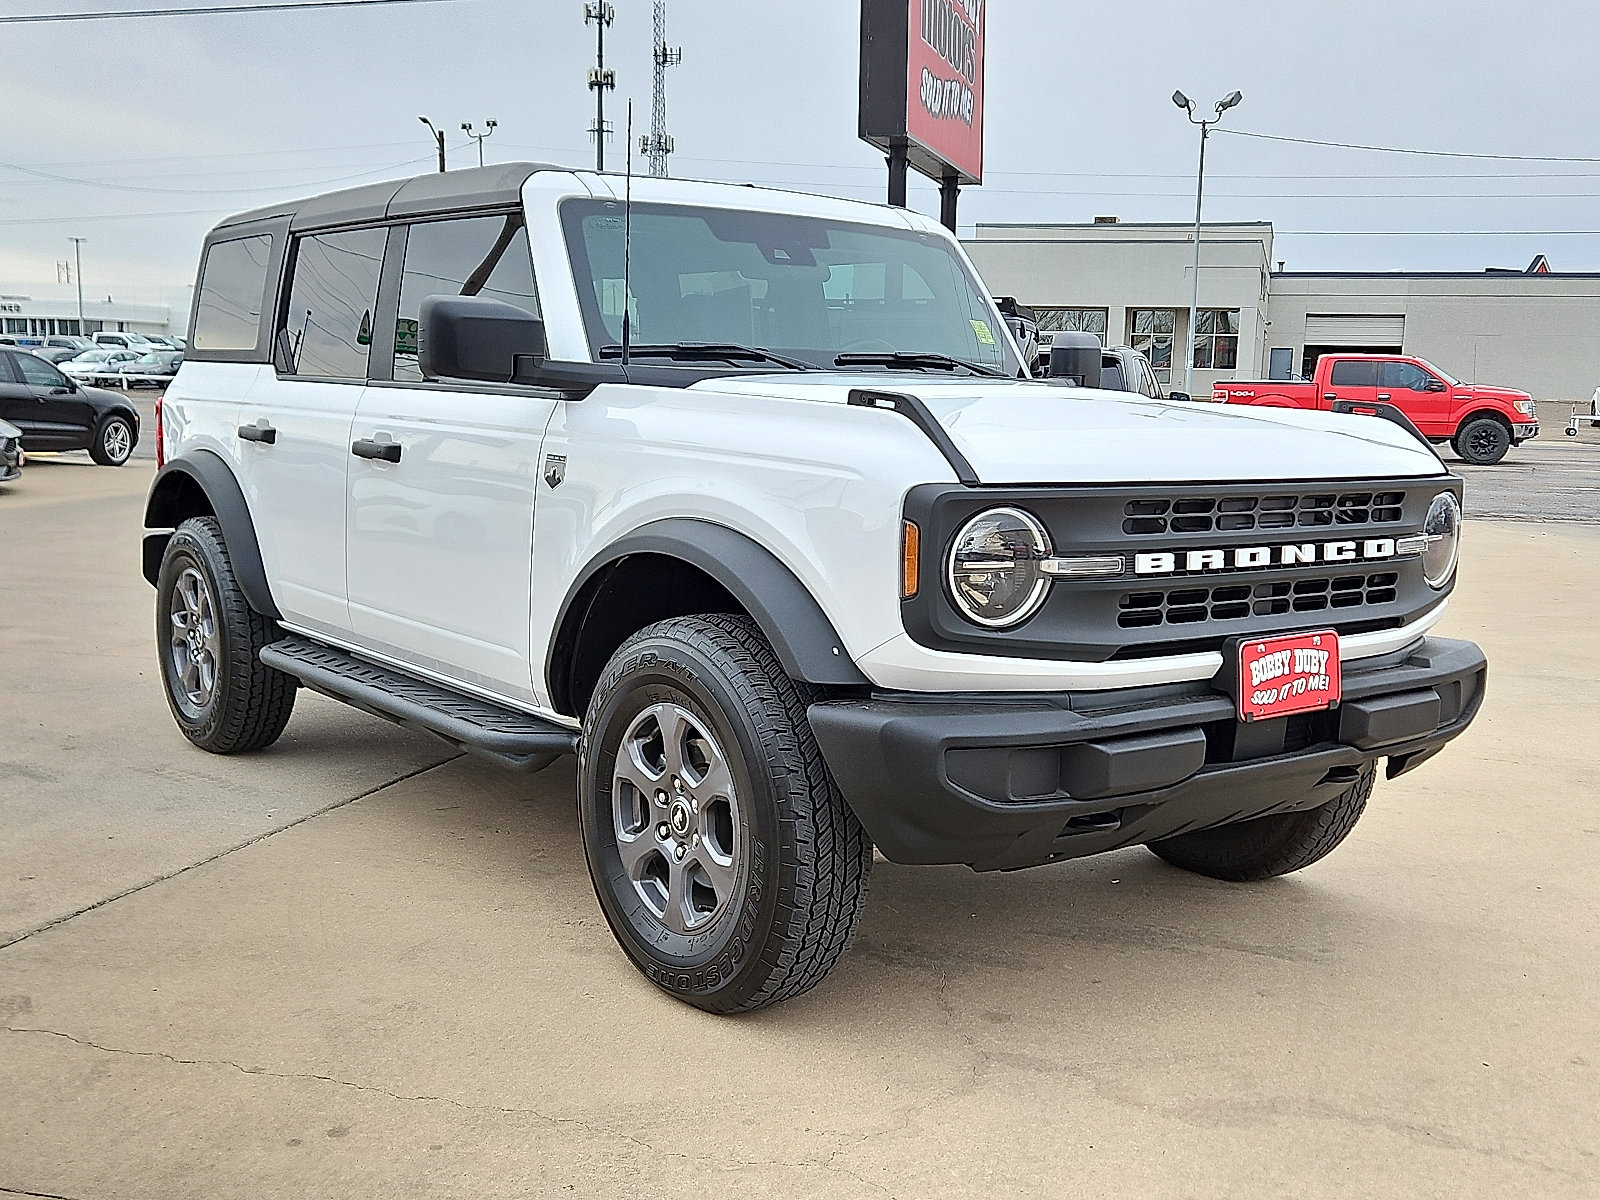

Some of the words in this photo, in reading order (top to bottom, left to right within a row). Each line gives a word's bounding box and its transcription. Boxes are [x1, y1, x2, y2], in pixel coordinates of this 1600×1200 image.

[920, 67, 942, 118] SOLD
[1134, 538, 1395, 574] BRONCO
[1249, 649, 1292, 686] BOBBY
[1293, 648, 1330, 674] DUBY
[1250, 688, 1278, 705] SOLD
[1278, 682, 1292, 701] IT
[1292, 677, 1307, 696] TO
[1307, 674, 1330, 691] ME!
